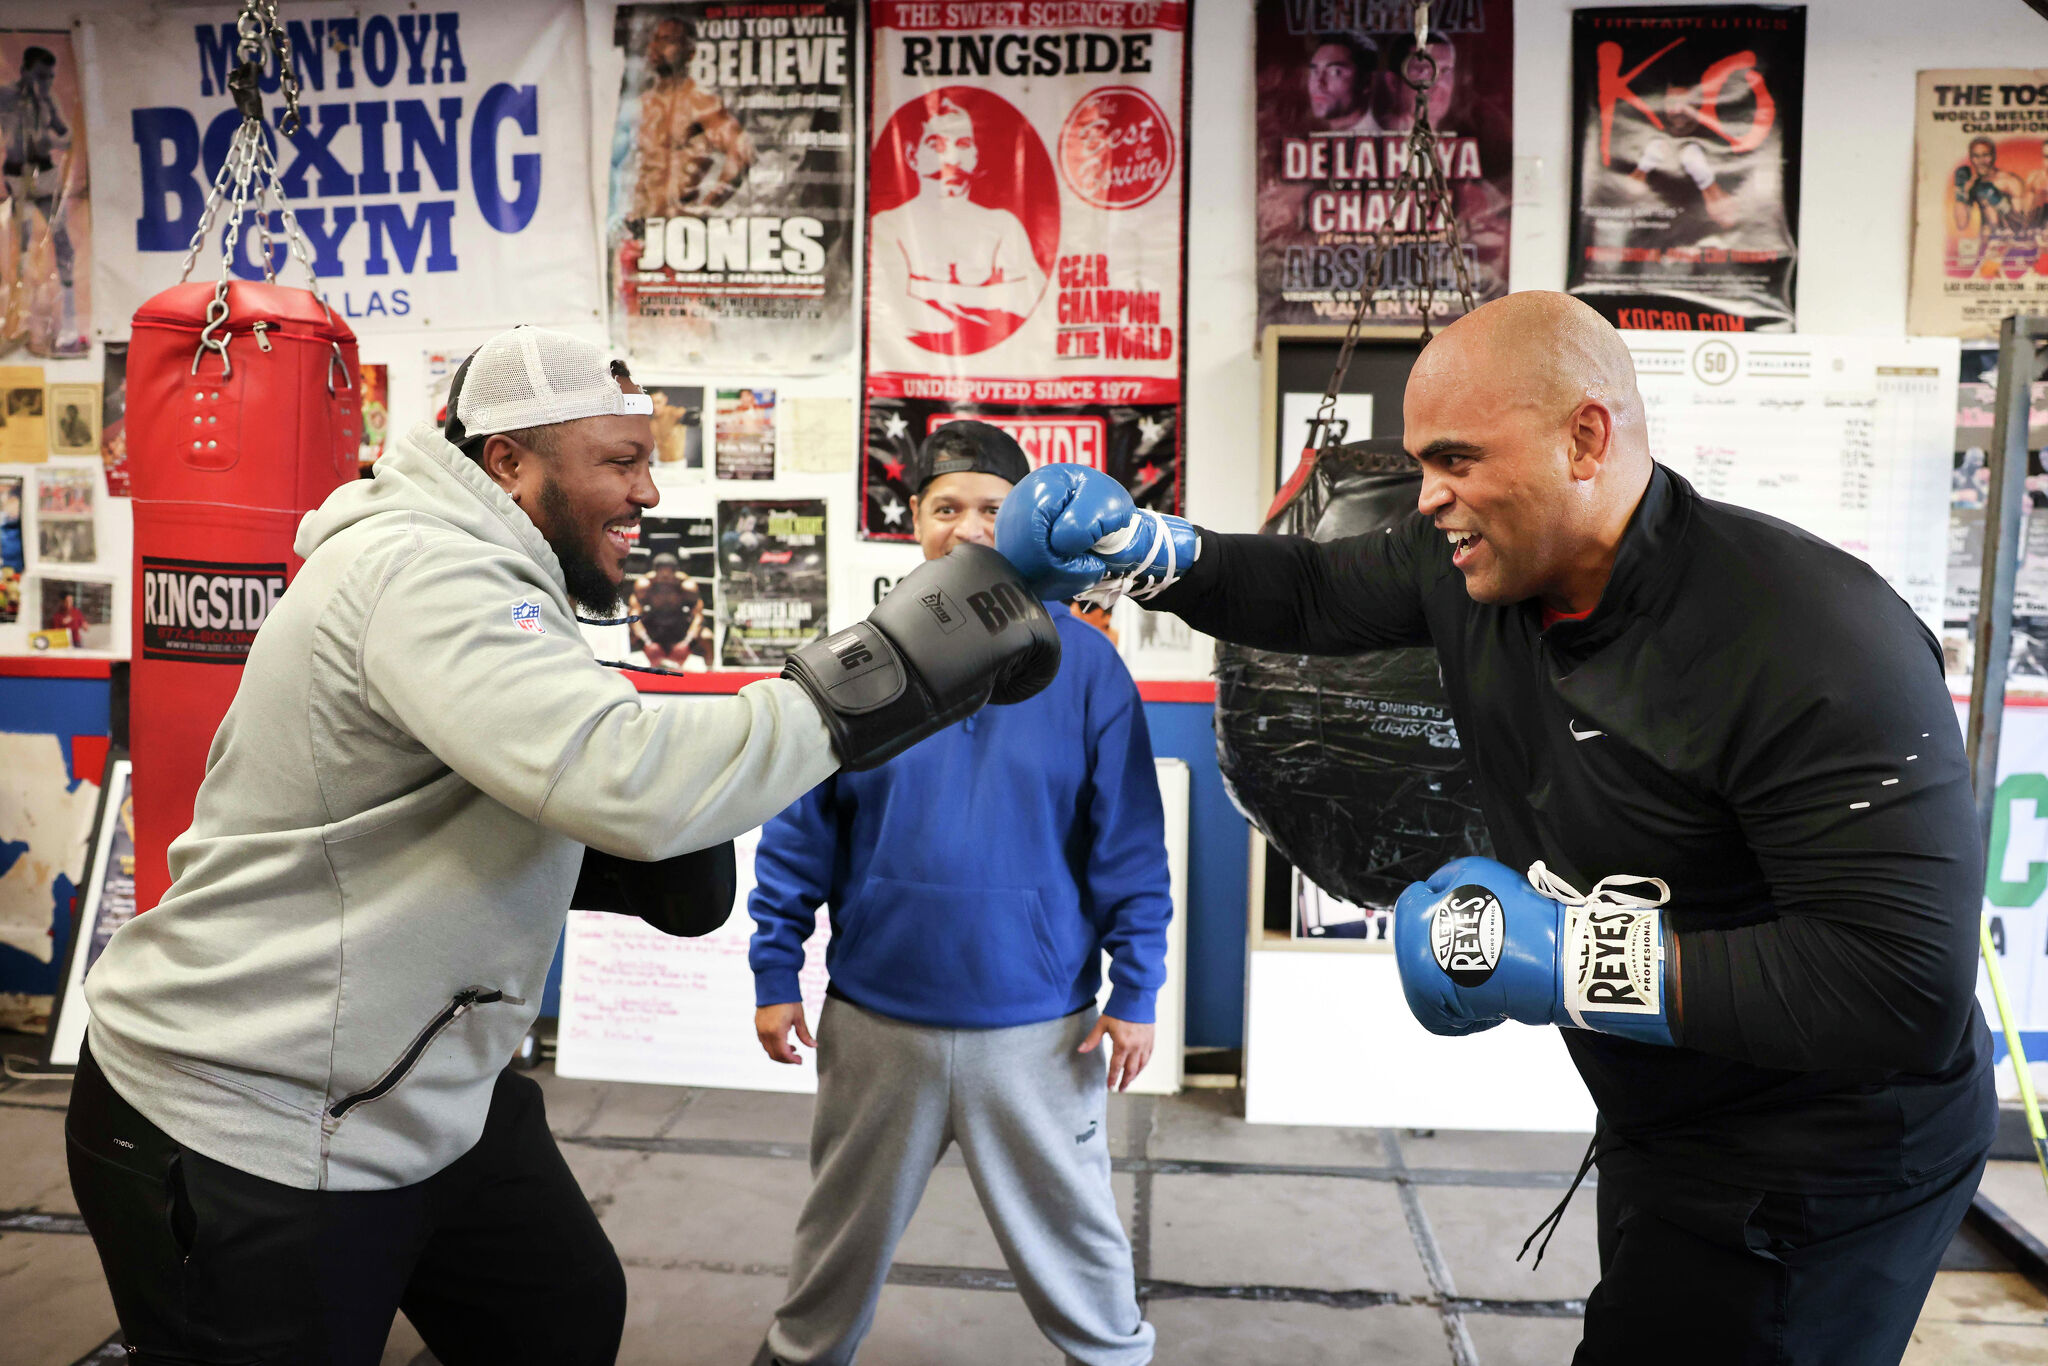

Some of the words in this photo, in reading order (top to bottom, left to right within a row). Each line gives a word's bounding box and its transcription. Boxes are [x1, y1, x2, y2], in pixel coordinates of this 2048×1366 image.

[696, 19, 740, 38] YOU
[744, 18, 789, 37] TOO
[792, 16, 848, 35] WILL
[896, 4, 940, 27] THE
[946, 3, 1023, 27] SWEET
[1029, 2, 1125, 26] SCIENCE
[1130, 3, 1160, 25] OF
[195, 12, 467, 97] MONTOYA
[694, 38, 848, 86] BELIEVE
[902, 33, 1153, 76] RINGSIDE
[1934, 85, 1992, 106] THE
[1933, 111, 1990, 121] WORLD
[1995, 111, 2048, 121] WELTE
[1079, 116, 1154, 157] Best
[131, 82, 541, 252] BOXING
[1284, 139, 1328, 179] DE
[221, 200, 457, 281] GYM
[639, 216, 825, 274] JONES
[1058, 254, 1109, 289] GEAR
[322, 289, 411, 317] LAS
[1058, 290, 1160, 325] CHAMPION
[1617, 308, 1746, 332] KOCBDCOM
[1103, 326, 1173, 360] WORLD
[1704, 352, 1727, 373] 50
[903, 379, 1032, 400] UNDISPUTED
[1034, 381, 1096, 400] SINCE
[1100, 381, 1144, 400] 1977
[1018, 426, 1094, 471] SIDE
[144, 571, 283, 630] RINGSIDE
[517, 618, 543, 633] NFL
[1344, 697, 1376, 712] TAPE
[1378, 700, 1444, 718] FLASHING
[1450, 897, 1492, 971] REYES
[1586, 911, 1647, 1006] REYES
[1643, 920, 1651, 992] PROFESIONAL
